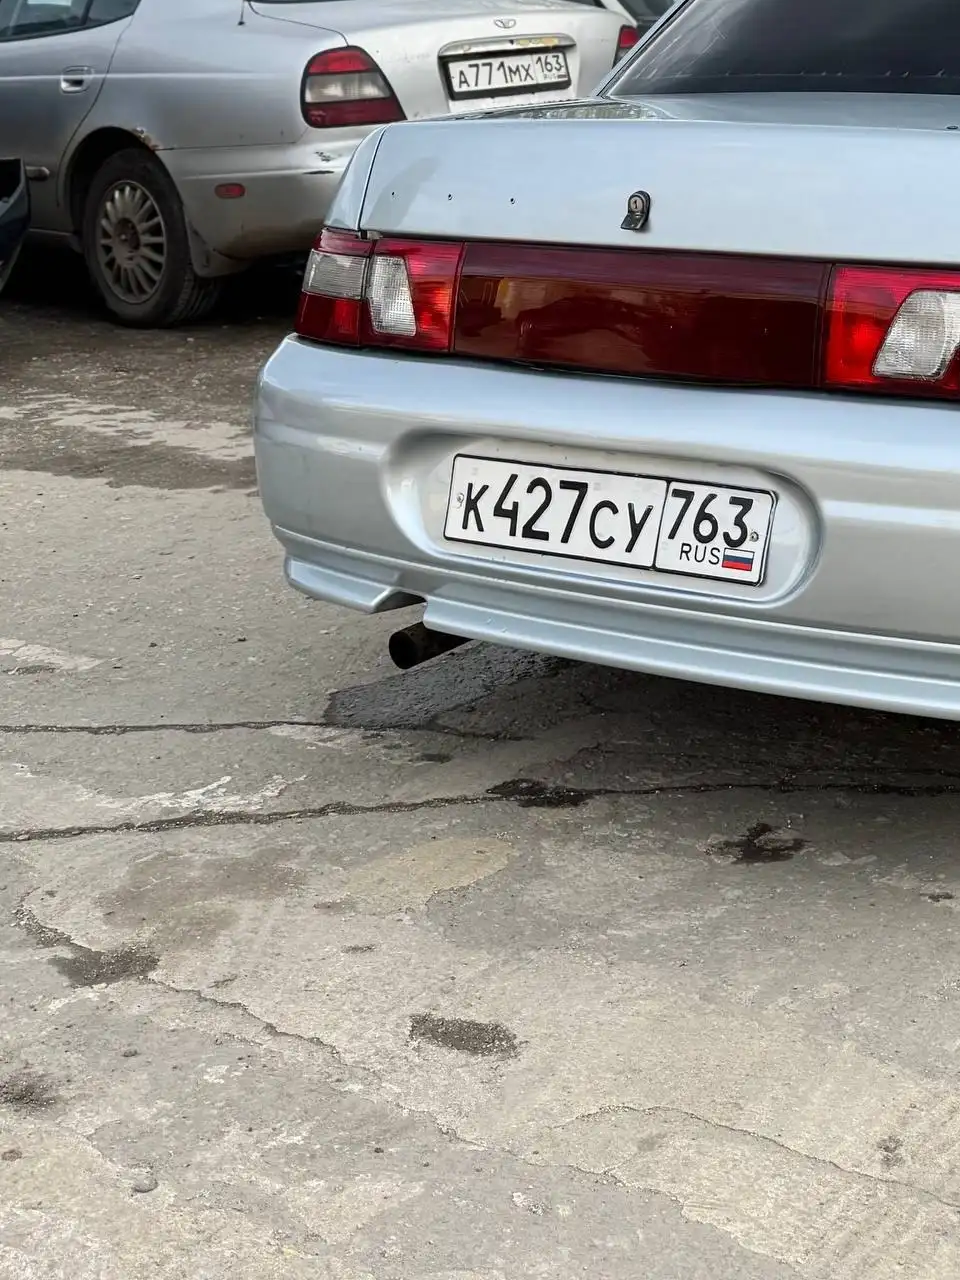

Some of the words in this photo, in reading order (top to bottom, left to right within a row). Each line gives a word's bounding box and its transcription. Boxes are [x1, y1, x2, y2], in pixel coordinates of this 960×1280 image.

[458, 61, 534, 89] А771МХ
[536, 55, 561, 73] 163
[461, 473, 654, 553] К427СУ
[667, 488, 754, 548] 763
[679, 542, 720, 566] RUS
